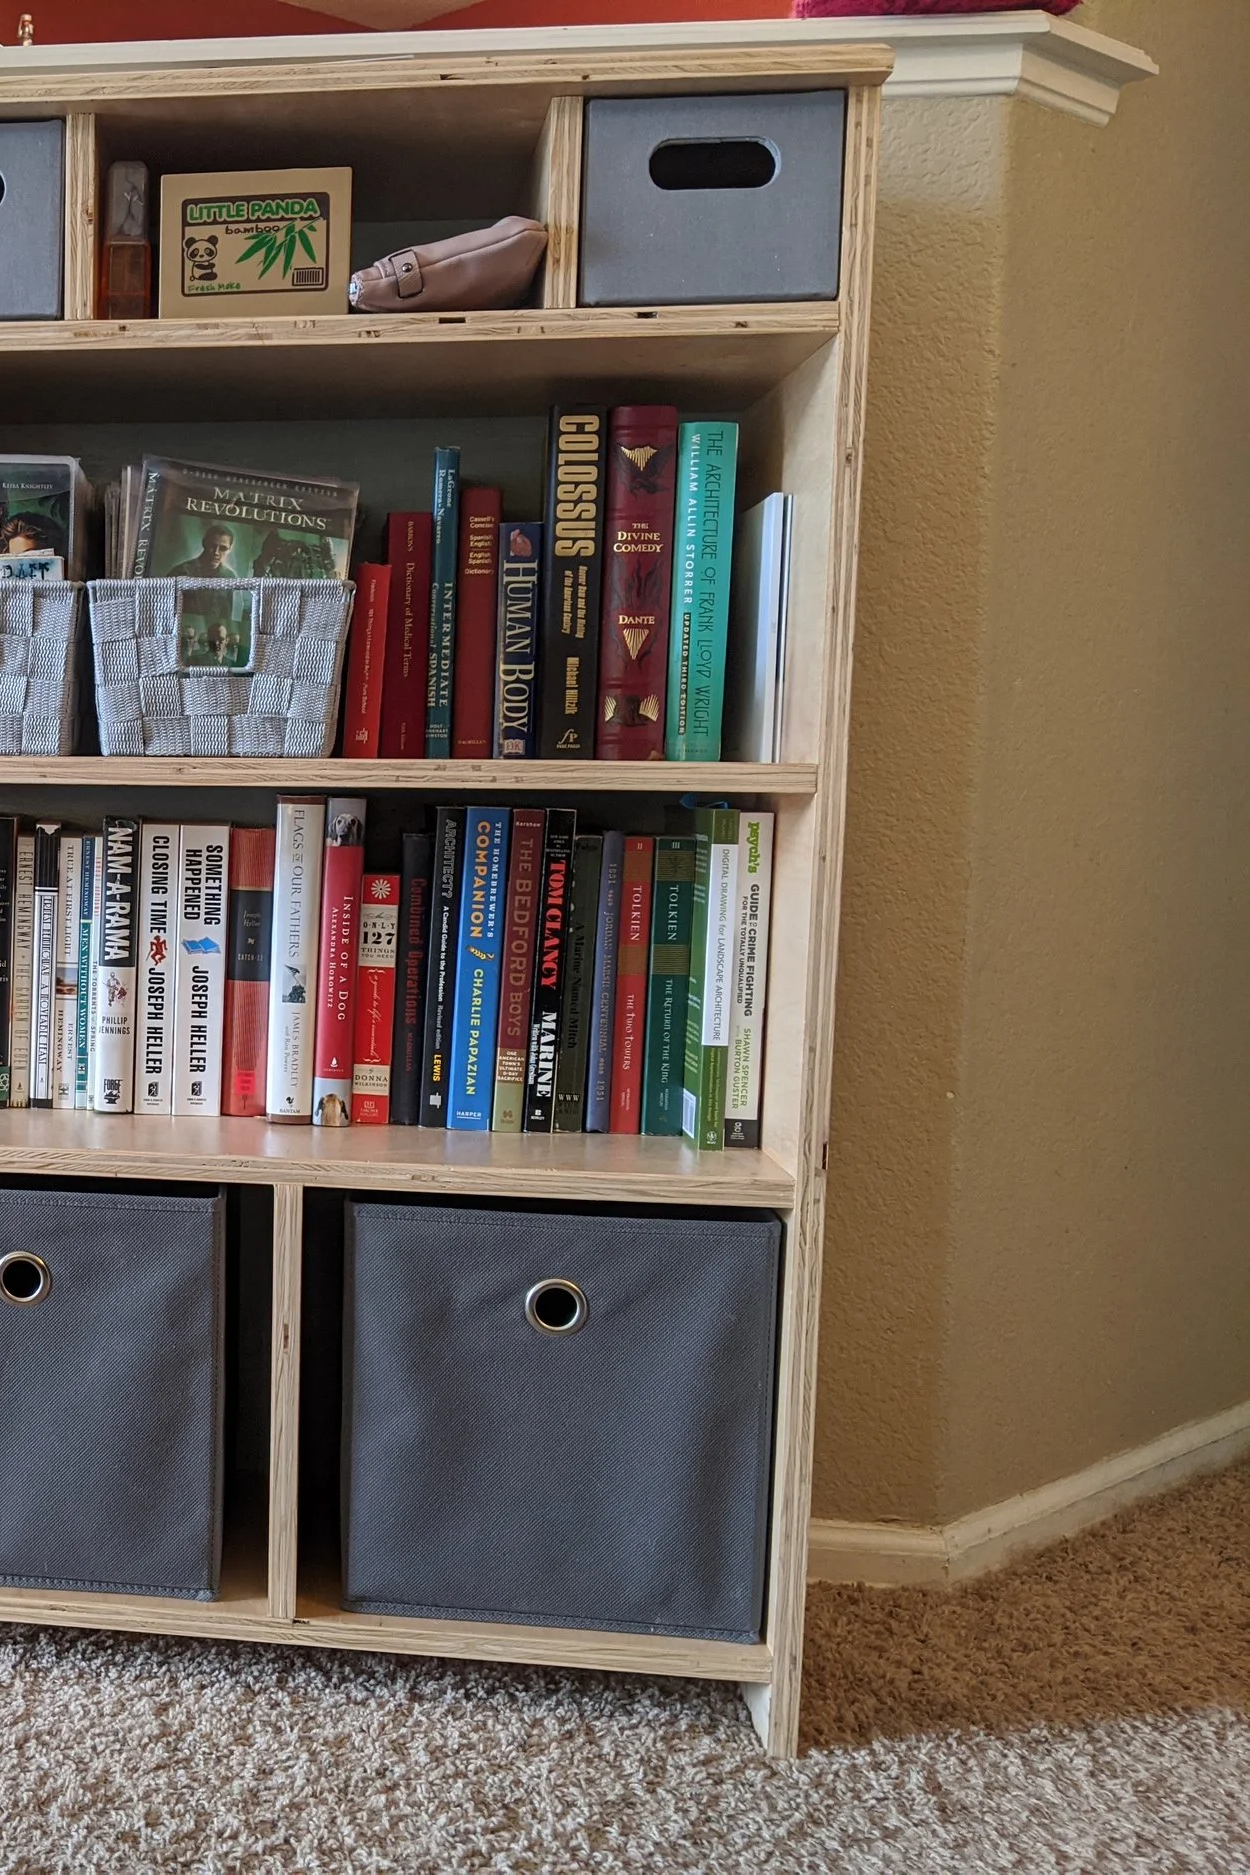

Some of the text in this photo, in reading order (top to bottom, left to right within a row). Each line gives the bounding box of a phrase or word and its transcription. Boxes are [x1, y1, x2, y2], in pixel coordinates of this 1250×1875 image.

[188, 198, 320, 222] LITTLE PANDA
[225, 224, 280, 235] bamboo
[185, 497, 327, 531] REVOLUTIONS
[213, 487, 305, 510] MATRIX
[554, 414, 600, 557] COLOSSUS
[683, 433, 701, 604] WILLIAM ALLIN STORRER
[613, 542, 663, 553] COMEDY
[617, 530, 661, 541] DIVINE
[618, 615, 655, 625] DANTE
[693, 430, 724, 736] THE ARCHITECTURE OF FRANK LLOYD WRIGHT
[427, 653, 438, 708] SPANISH
[439, 582, 453, 707] INTERMEDIATE
[498, 559, 538, 733] HUMAN BODY
[183, 849, 202, 920] HAPPENED
[203, 844, 223, 926] SOMETHING
[470, 821, 490, 937] COMPANION
[746, 821, 760, 874] psych's
[103, 827, 132, 961] NAM-A-RAMA
[340, 896, 353, 943] INSIDE
[540, 859, 566, 990] TOM CLANCY
[630, 885, 642, 941] TOLKIEN
[667, 885, 679, 941] TOLKIEN
[748, 884, 760, 921] GUIDE
[145, 836, 169, 1074] CLOSING TIME JOSEPH HELLER
[327, 907, 339, 1008] ALEXANDRA HOROWITZ
[340, 952, 348, 968] OF
[506, 839, 533, 1036] THE BEDFORD BOYS
[713, 848, 730, 1040] DIGITAL DRAWING for LANDSCAPE ARCHITECTURE
[744, 928, 758, 1017] CRIME FIGHTING
[189, 965, 208, 1073] JOSEPH HELLER
[466, 968, 483, 1095] CHARLIE PAPAZIAN
[537, 1011, 557, 1097] MARINE
[432, 1054, 442, 1082] LEWIS
